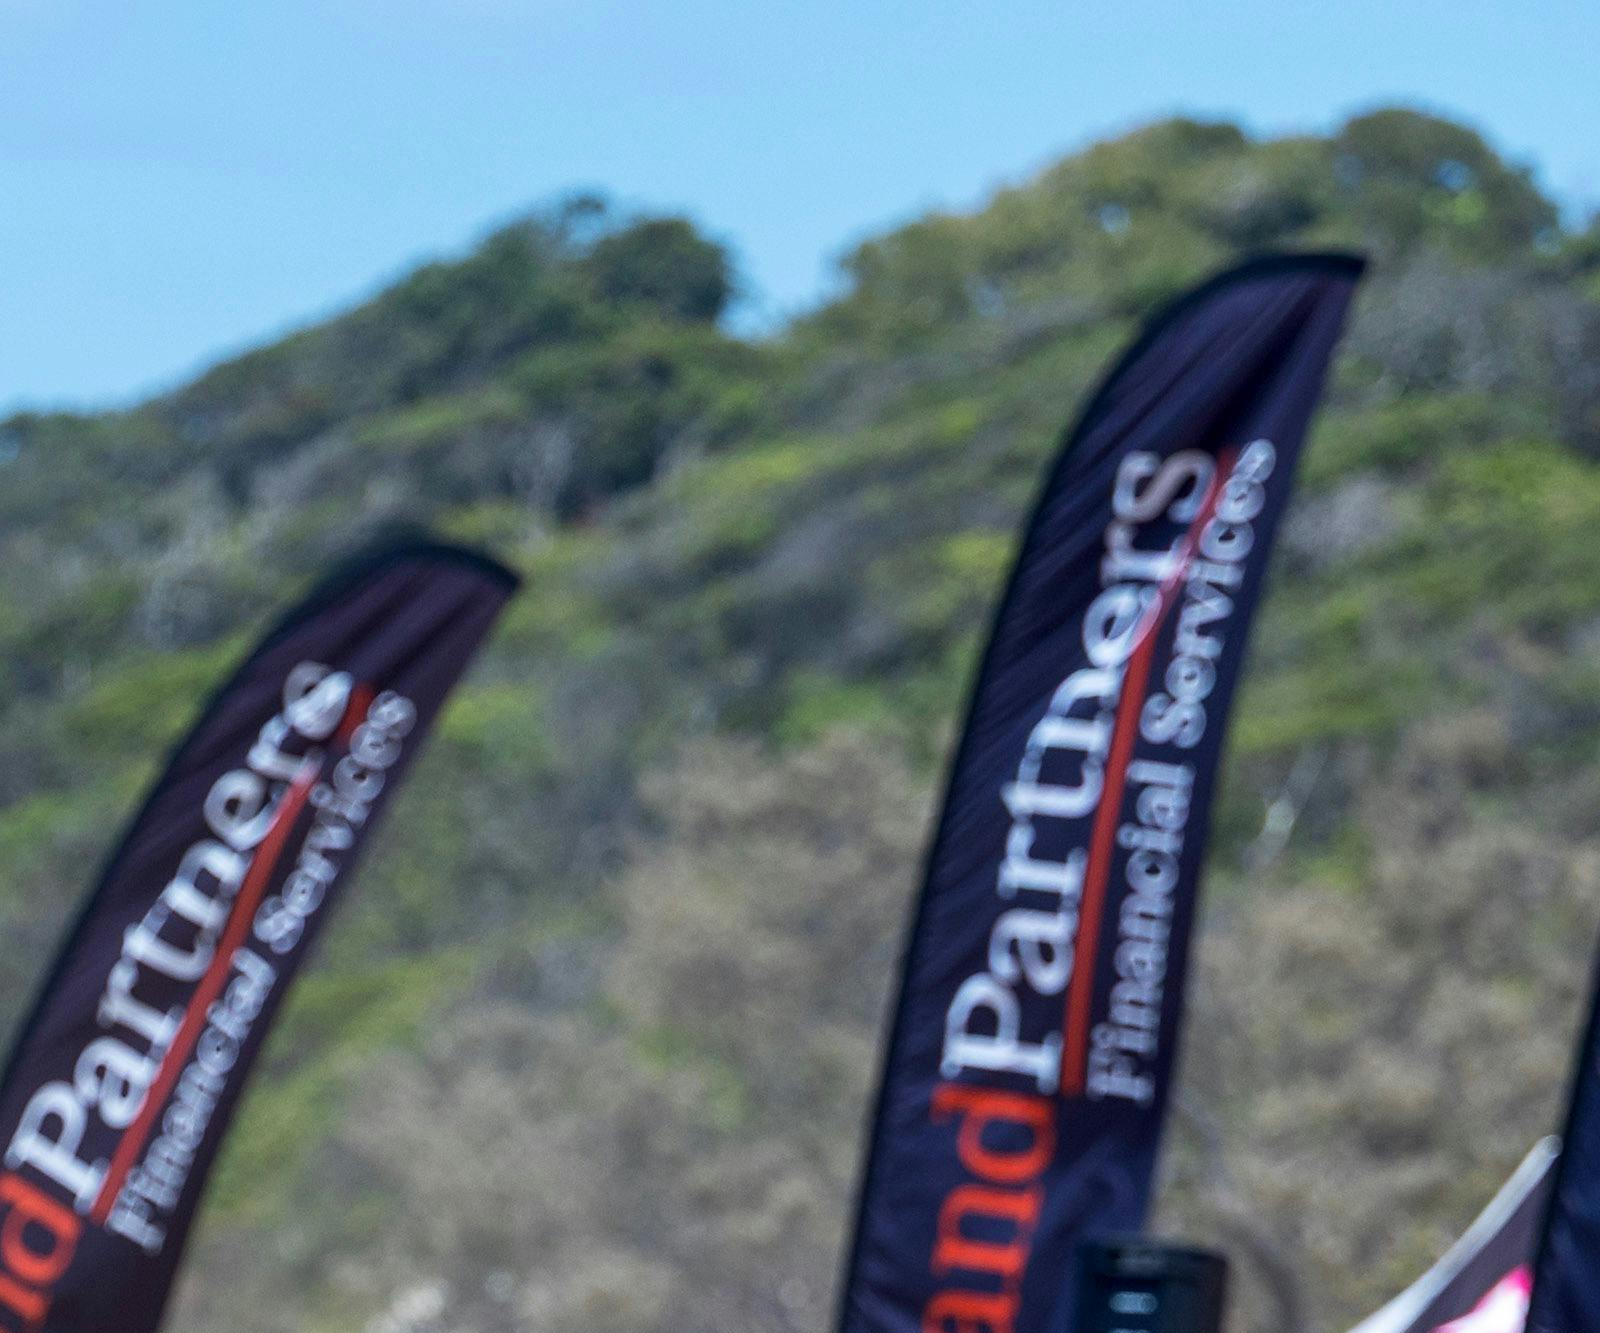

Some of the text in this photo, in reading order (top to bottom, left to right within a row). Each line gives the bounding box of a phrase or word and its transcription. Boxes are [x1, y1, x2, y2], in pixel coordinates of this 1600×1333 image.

[104, 689, 419, 1257] Financial Services
[1085, 437, 1277, 1107] Financial Services
